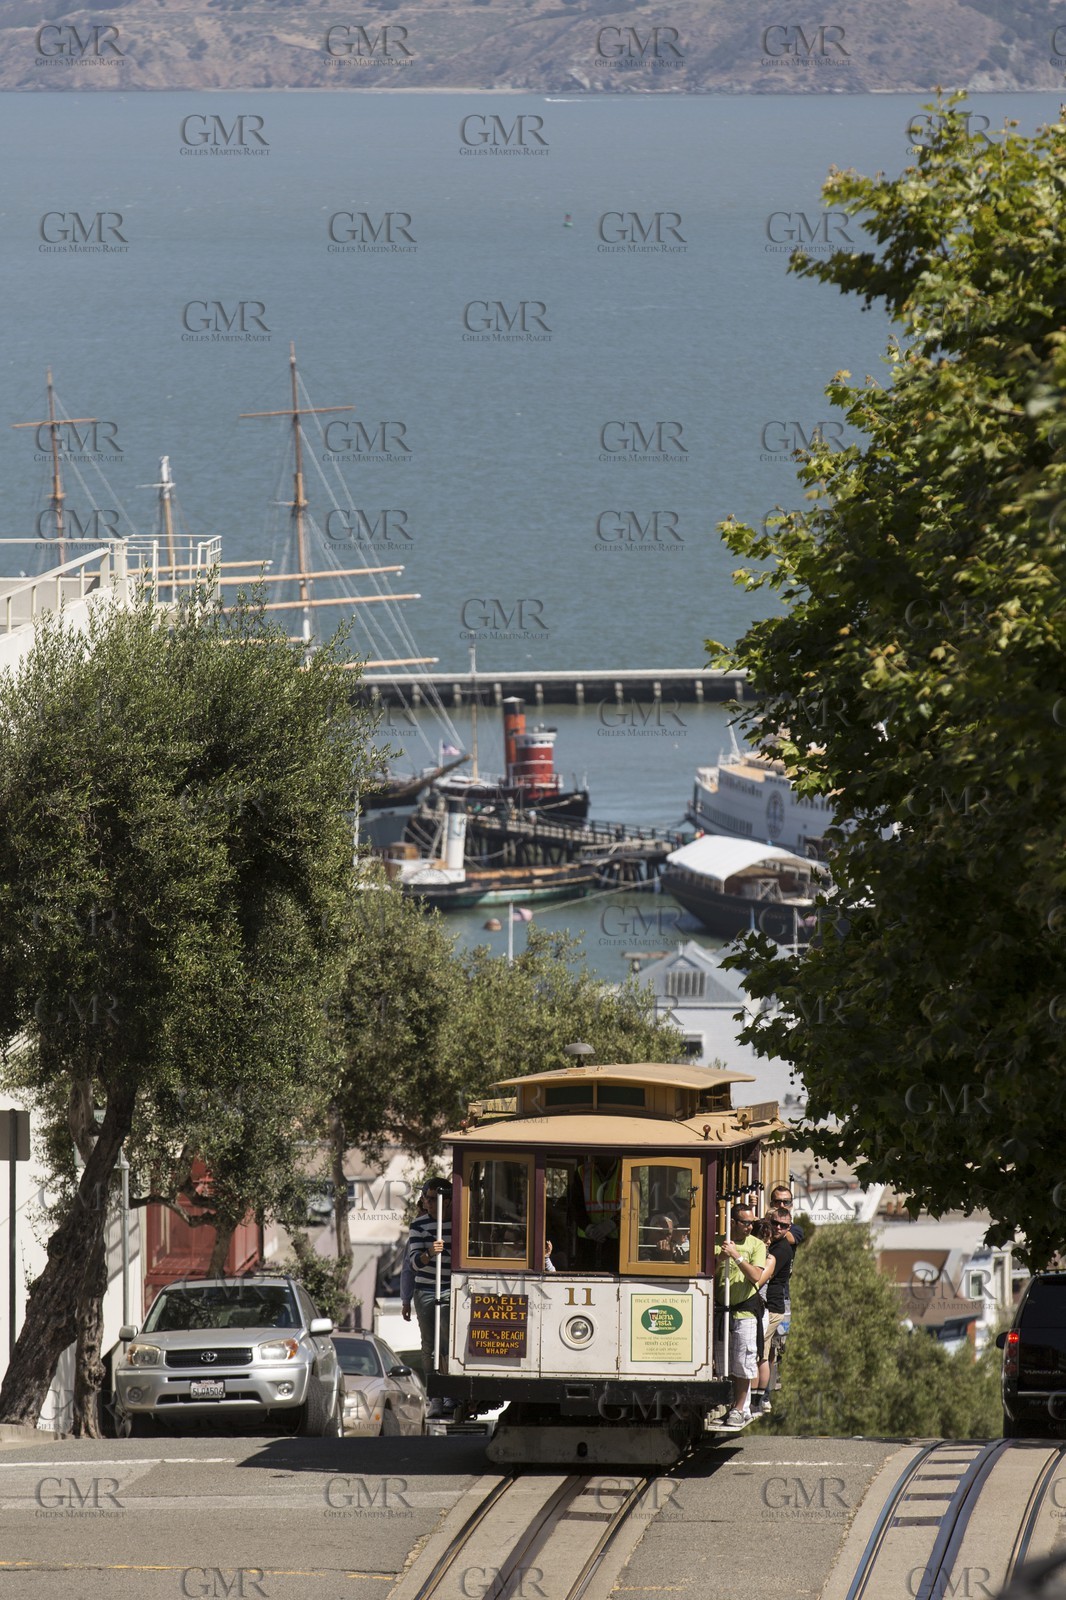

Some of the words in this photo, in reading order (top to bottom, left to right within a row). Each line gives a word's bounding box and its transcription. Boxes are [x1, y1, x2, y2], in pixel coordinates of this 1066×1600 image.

[475, 1296, 526, 1306] POWELL
[564, 1287, 596, 1306] 11
[473, 1311, 526, 1320] MARKET
[472, 1330, 490, 1339] HYDE
[476, 1340, 519, 1348] FISHERMANS
[485, 1347, 509, 1355] WHARF
